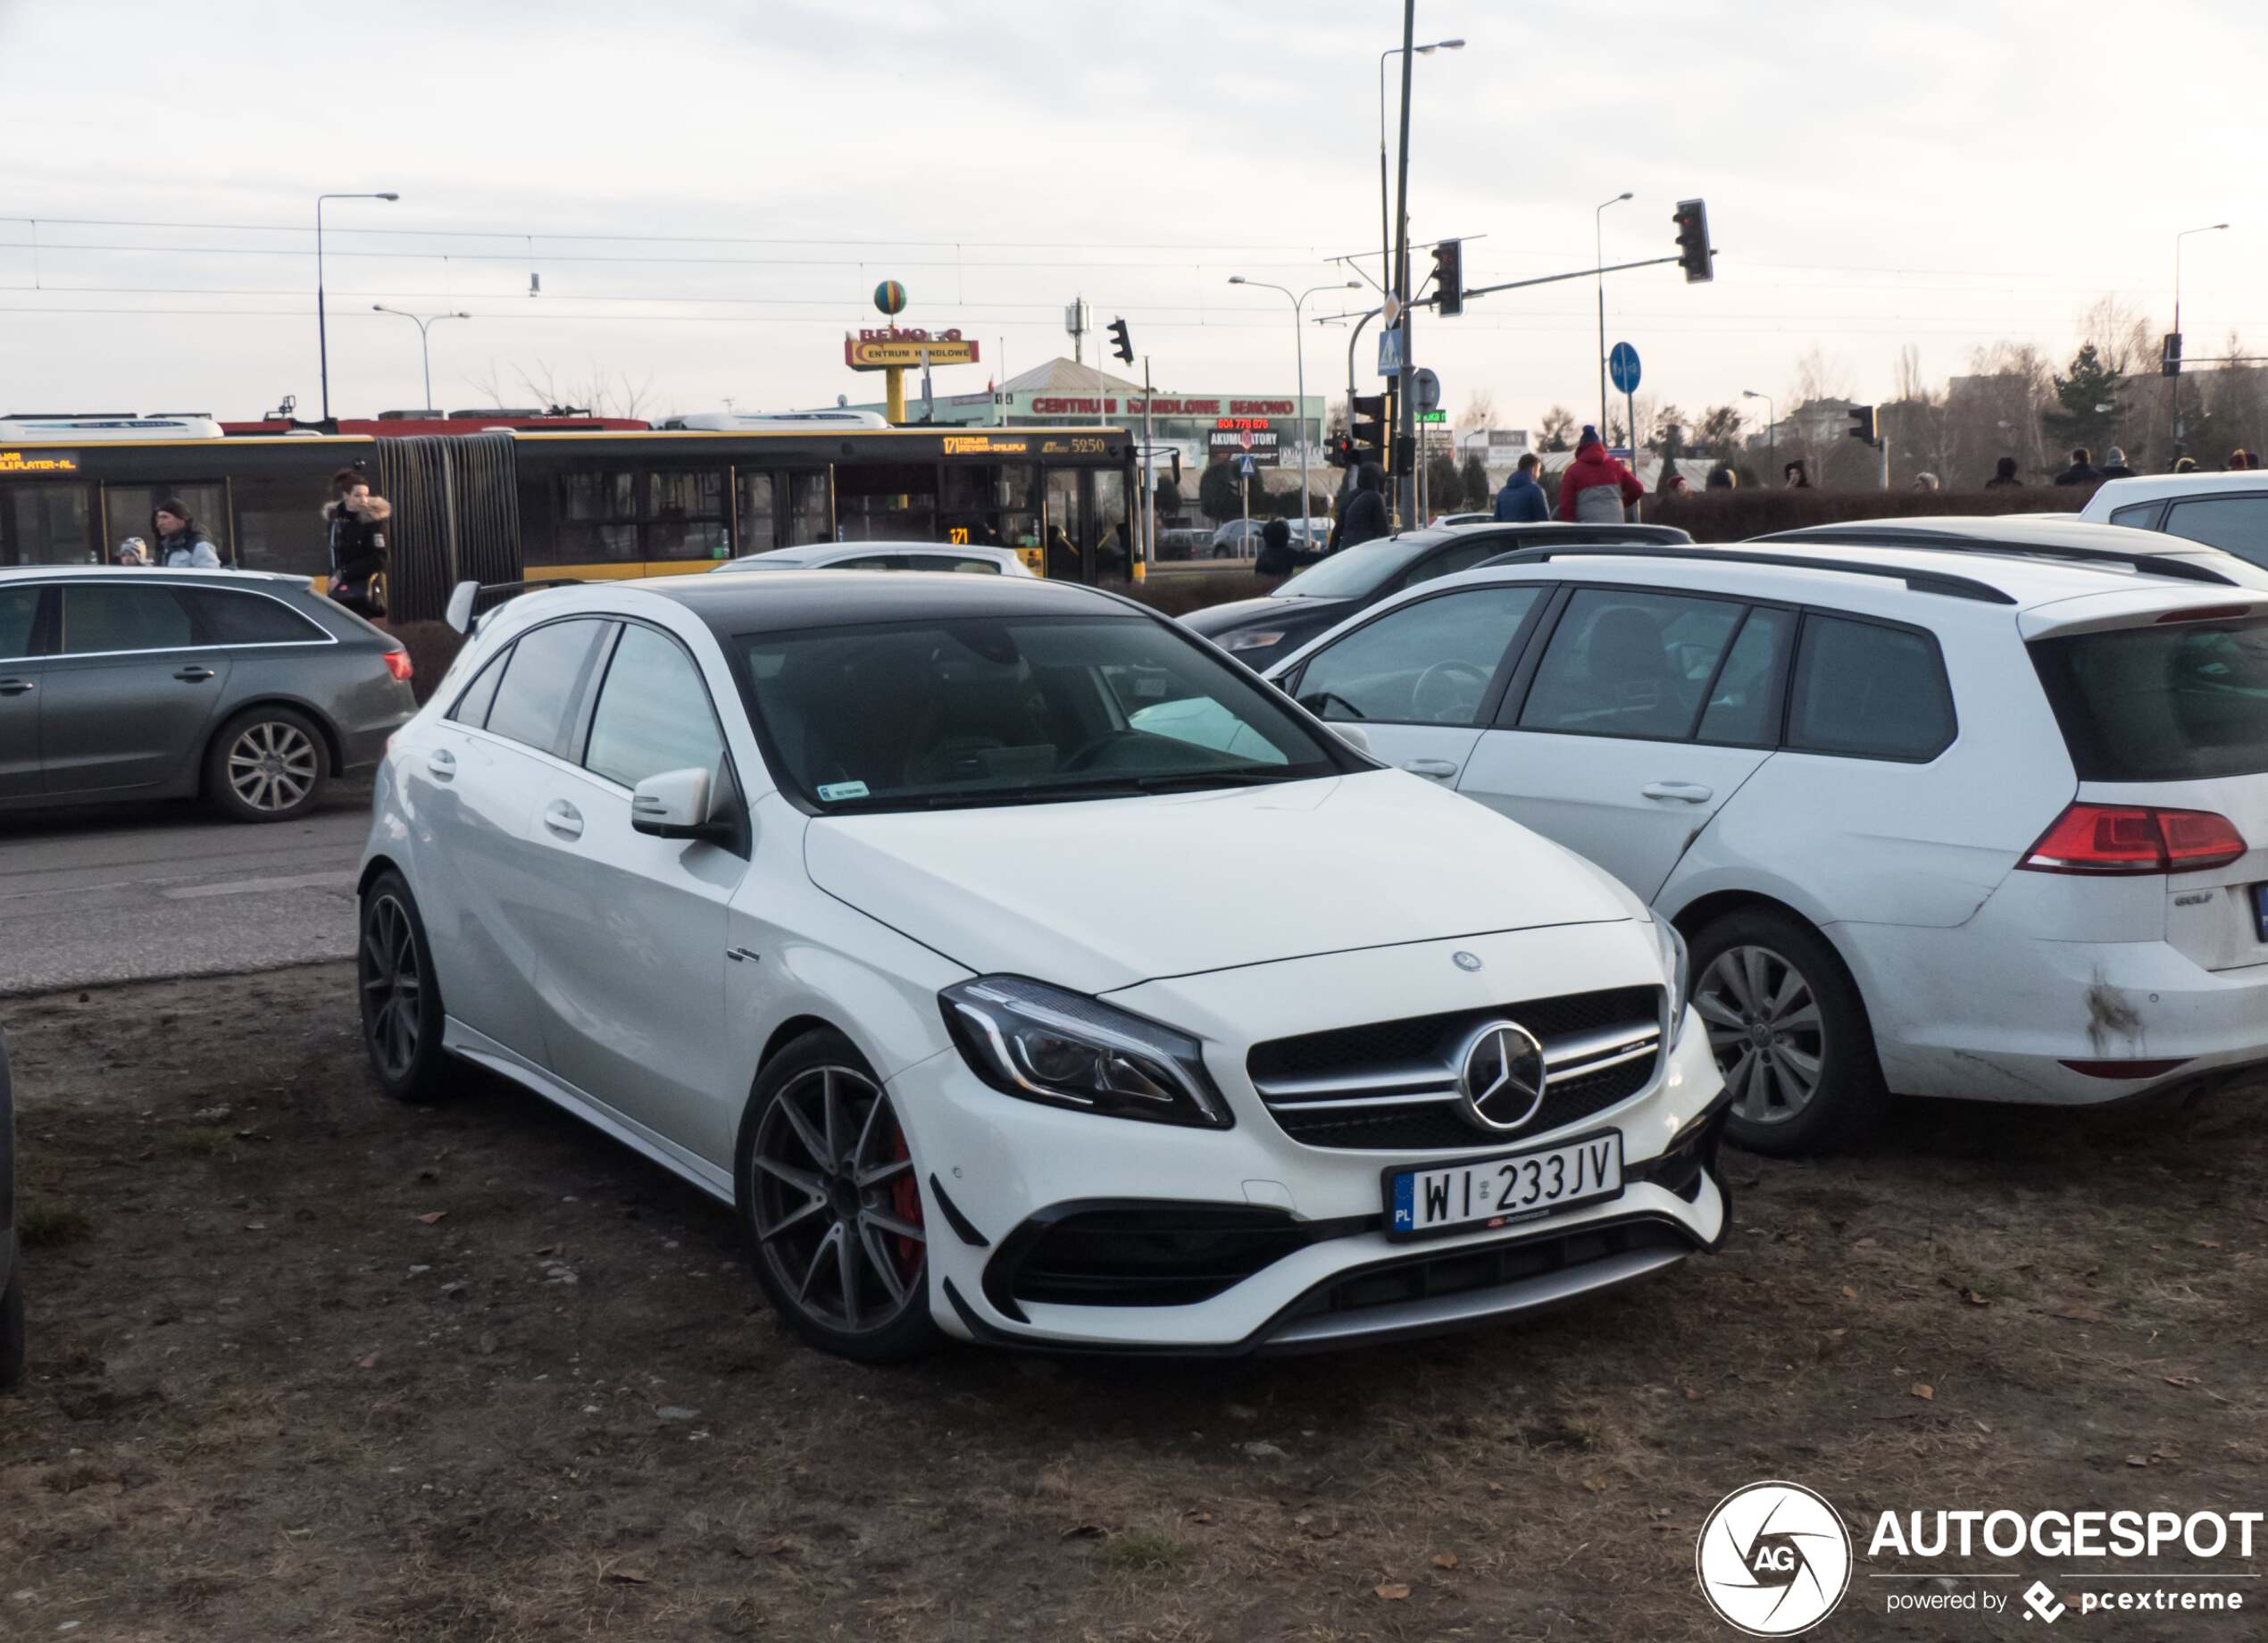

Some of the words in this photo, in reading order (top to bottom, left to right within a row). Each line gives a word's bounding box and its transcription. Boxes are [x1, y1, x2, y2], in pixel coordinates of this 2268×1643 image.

[859, 328, 962, 342] BEMOO
[914, 349, 971, 357] HNDLOWE
[1032, 397, 1118, 413] CENTRUM
[1127, 399, 1221, 414] HANDLOWE
[1230, 400, 1295, 414] BEMOWO
[943, 437, 959, 454] 171
[1071, 438, 1105, 454] 5250
[1425, 1171, 1471, 1222] WI
[1497, 1141, 1610, 1211] 233JV
[1396, 1210, 1411, 1223] PL
